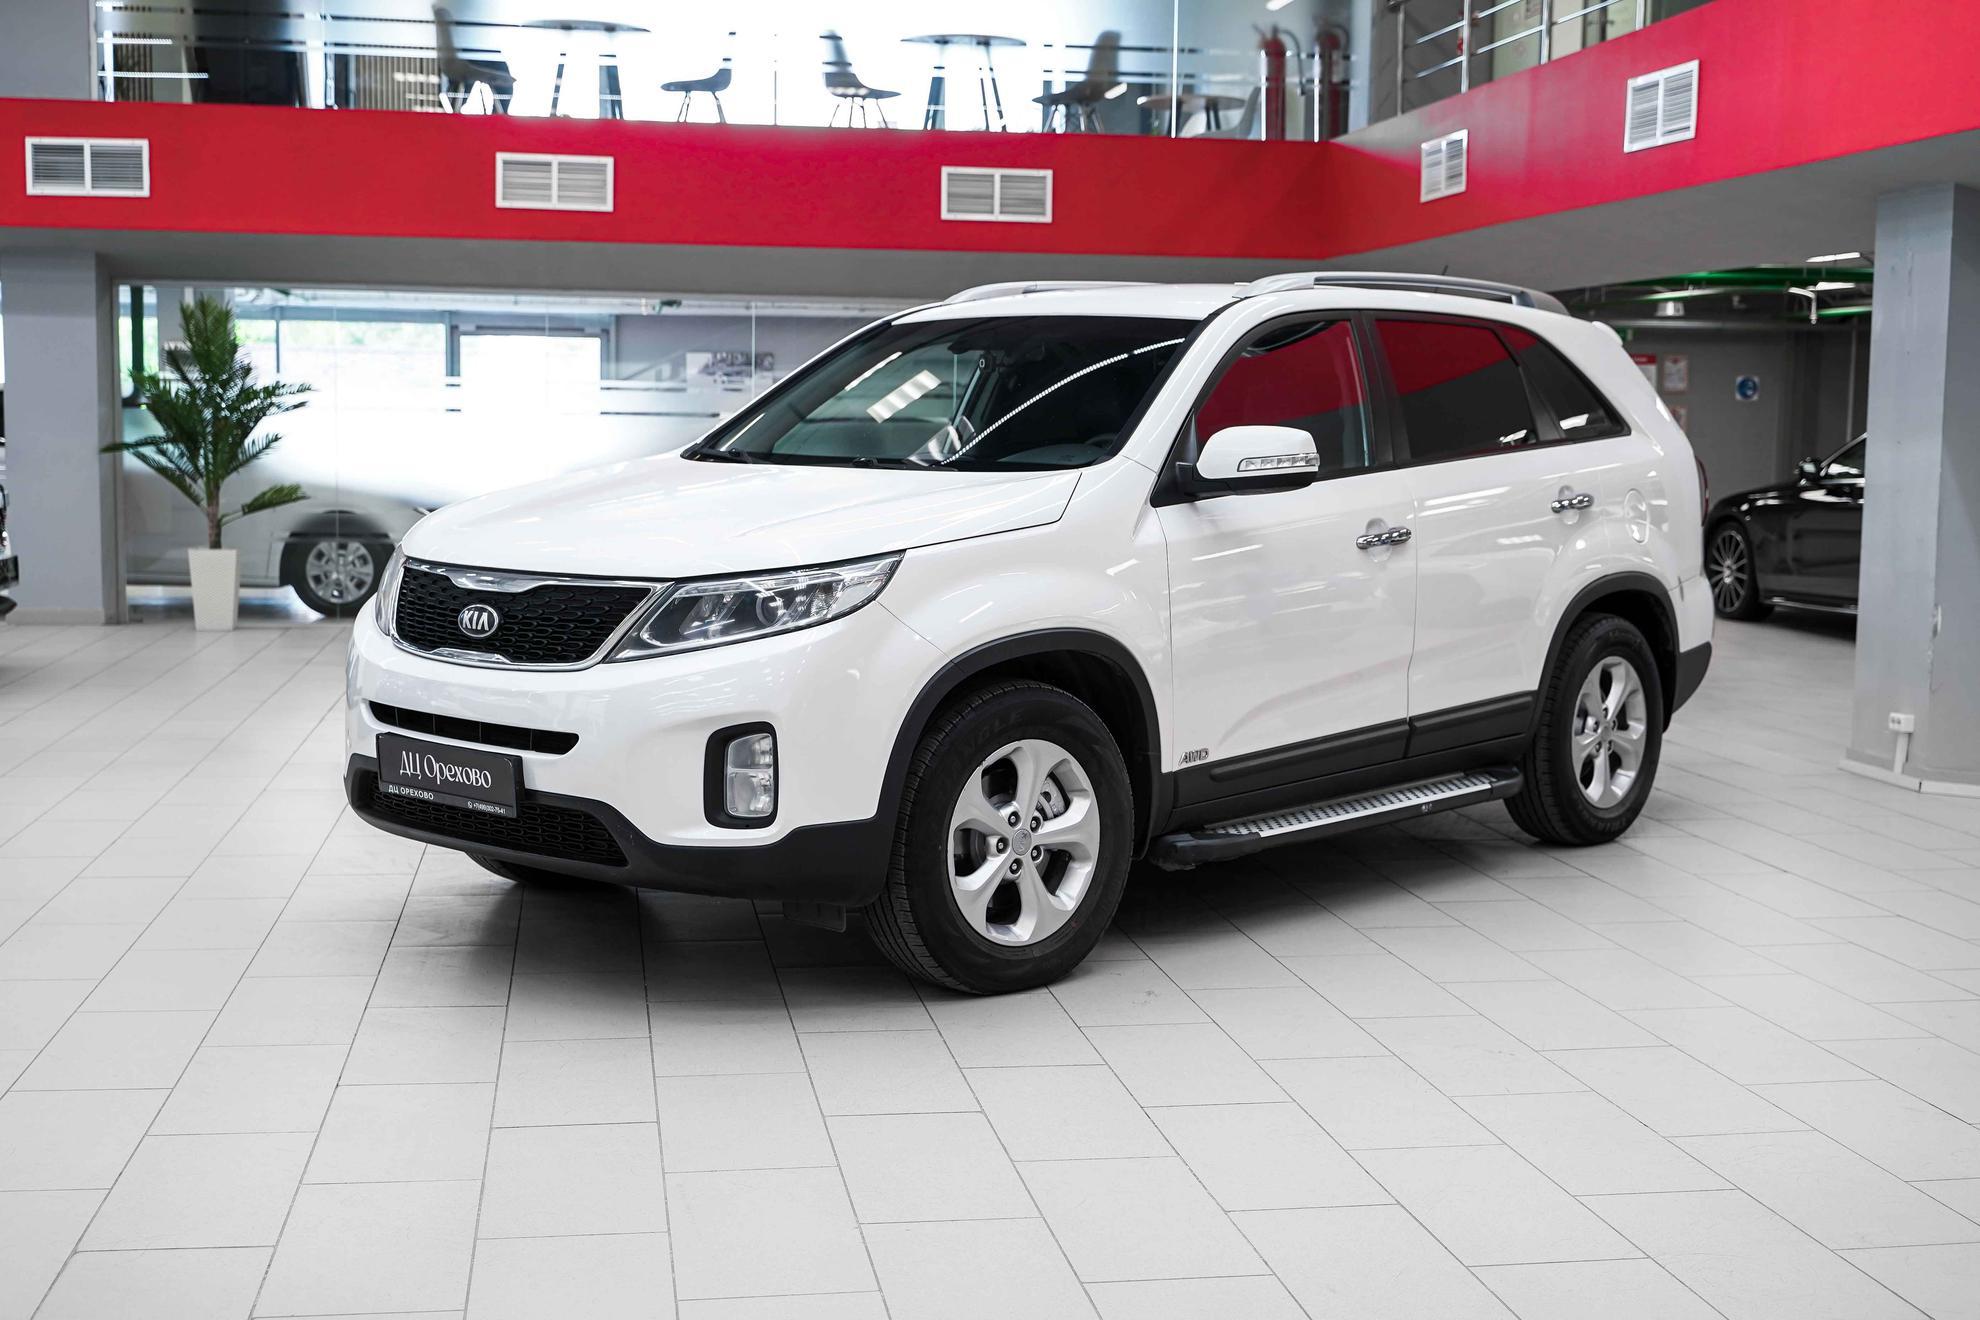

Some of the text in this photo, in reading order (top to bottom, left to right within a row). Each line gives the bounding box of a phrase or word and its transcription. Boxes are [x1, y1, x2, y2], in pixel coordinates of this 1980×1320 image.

[462, 611, 489, 630] KIA
[1178, 747, 1209, 766] AWD
[399, 750, 491, 788] ДЦ Орехово
[388, 784, 434, 800] ДЦ ОРЕХОВО
